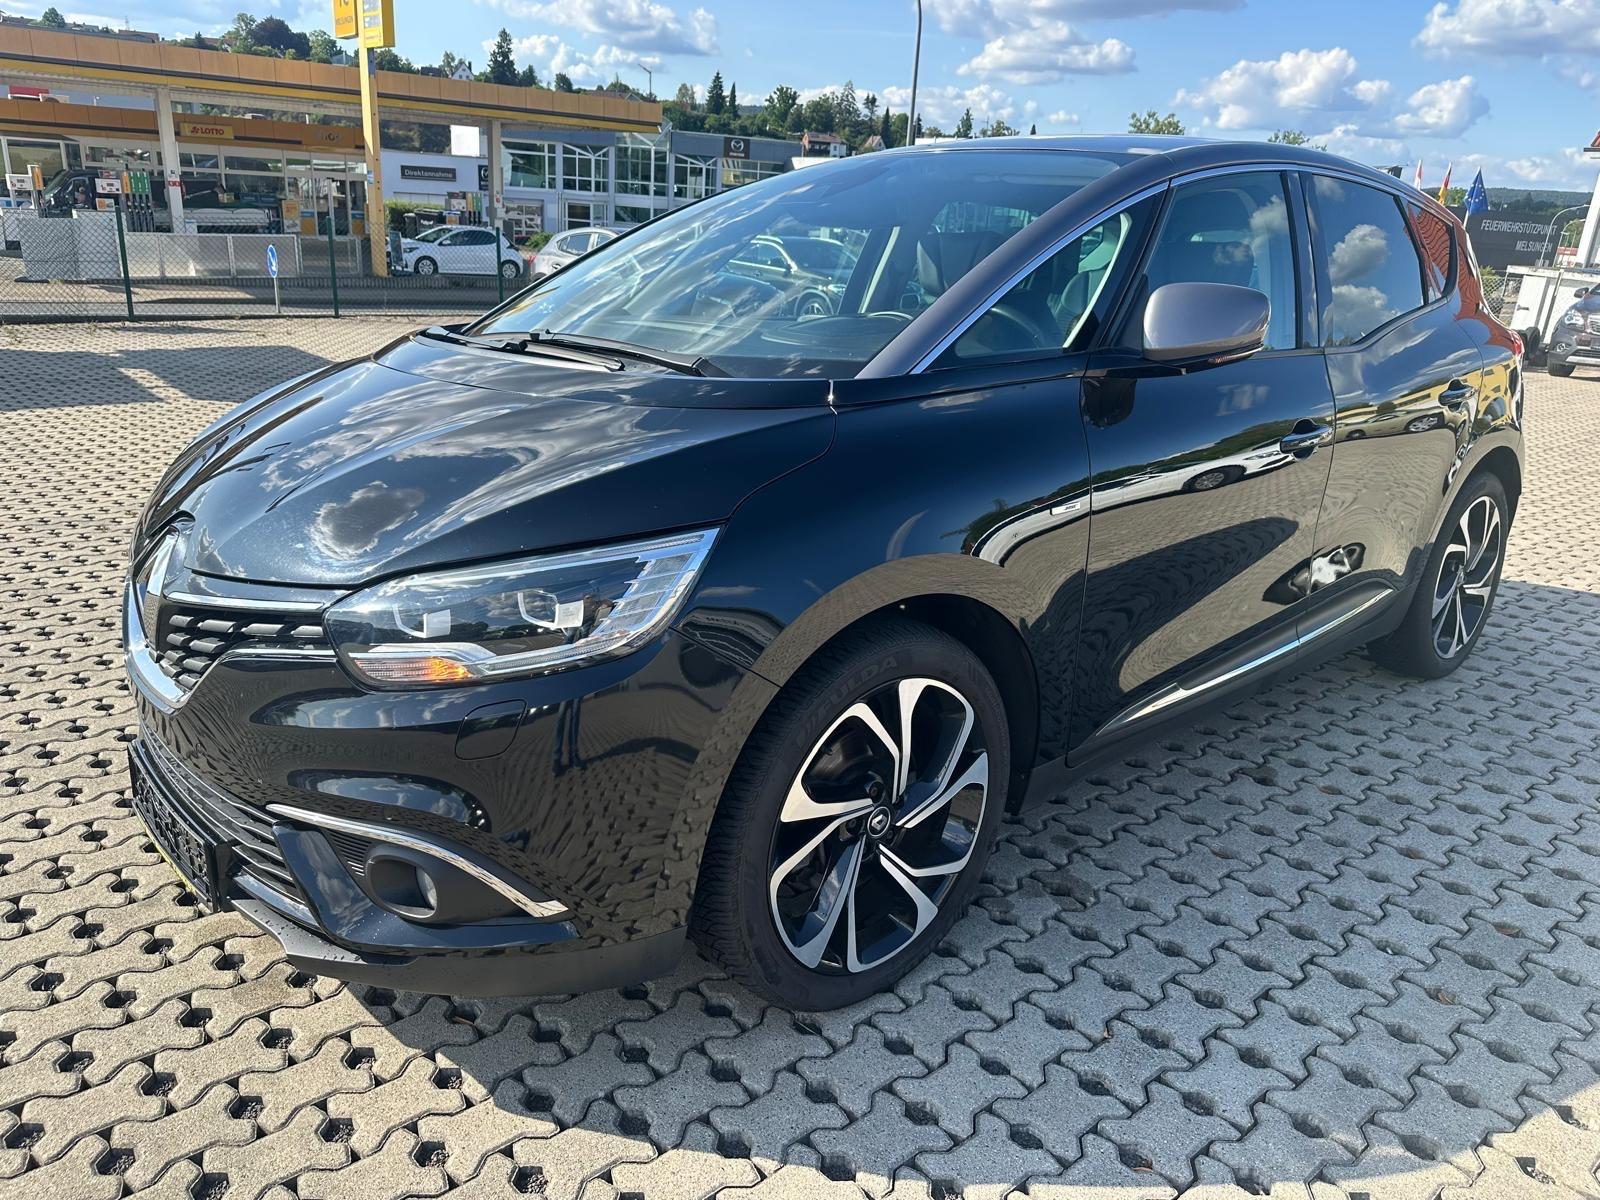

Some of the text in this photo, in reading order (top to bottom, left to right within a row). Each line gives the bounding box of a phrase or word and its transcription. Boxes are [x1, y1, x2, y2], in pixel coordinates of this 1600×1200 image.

[200, 127, 225, 136] LOTTO
[404, 168, 453, 178] Direktannahme
[1480, 219, 1557, 235] FEUERWEHRSTÜTZPUNKT
[1515, 240, 1553, 252] MELSUNGEN
